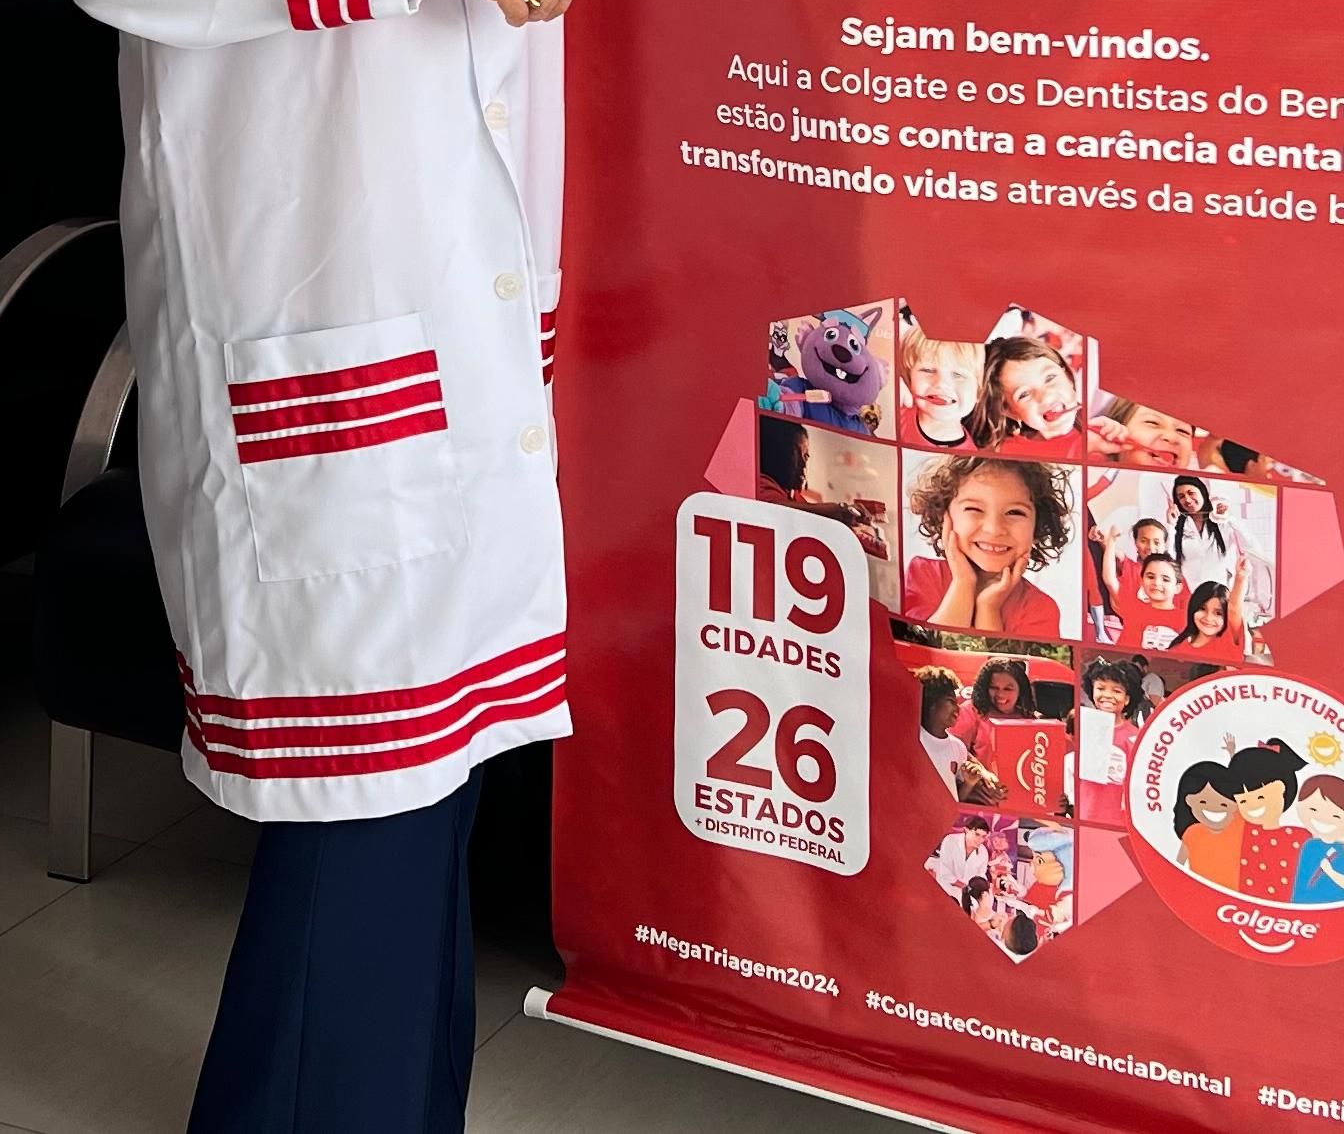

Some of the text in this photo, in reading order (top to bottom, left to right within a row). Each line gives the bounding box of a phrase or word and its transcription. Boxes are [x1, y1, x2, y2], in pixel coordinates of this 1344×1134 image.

[841, 17, 1209, 61] Sejam bem-vindos.
[728, 55, 787, 89] Aqui
[797, 70, 811, 89] a
[821, 67, 947, 103] Colgate
[958, 81, 976, 101] e
[987, 83, 1025, 104] os
[1038, 79, 1207, 112] Dentistas
[1219, 86, 1267, 115] do
[717, 104, 785, 131] estão
[791, 116, 889, 145] juntos
[899, 126, 1013, 153] contra
[1025, 134, 1045, 155] a
[1057, 130, 1217, 163] carência
[680, 141, 894, 194] transformando
[904, 169, 997, 201] vidas
[1008, 180, 1137, 209] através
[1148, 184, 1192, 213] da
[1205, 189, 1317, 221] saúde
[694, 515, 845, 634] 119
[701, 625, 840, 678] CIDADES
[706, 688, 837, 803] 26
[1031, 731, 1052, 807] Colgate
[1146, 731, 1174, 811] SORRISO
[1170, 685, 1267, 731] SAUDÁVEL,
[694, 782, 845, 844] ESTADOS
[706, 818, 775, 843] DISTRITO
[780, 833, 846, 865] FEDERAL
[635, 925, 839, 996] #MegaTriagem2024
[865, 990, 1231, 1097] #ColgateContraCarênciaDental
